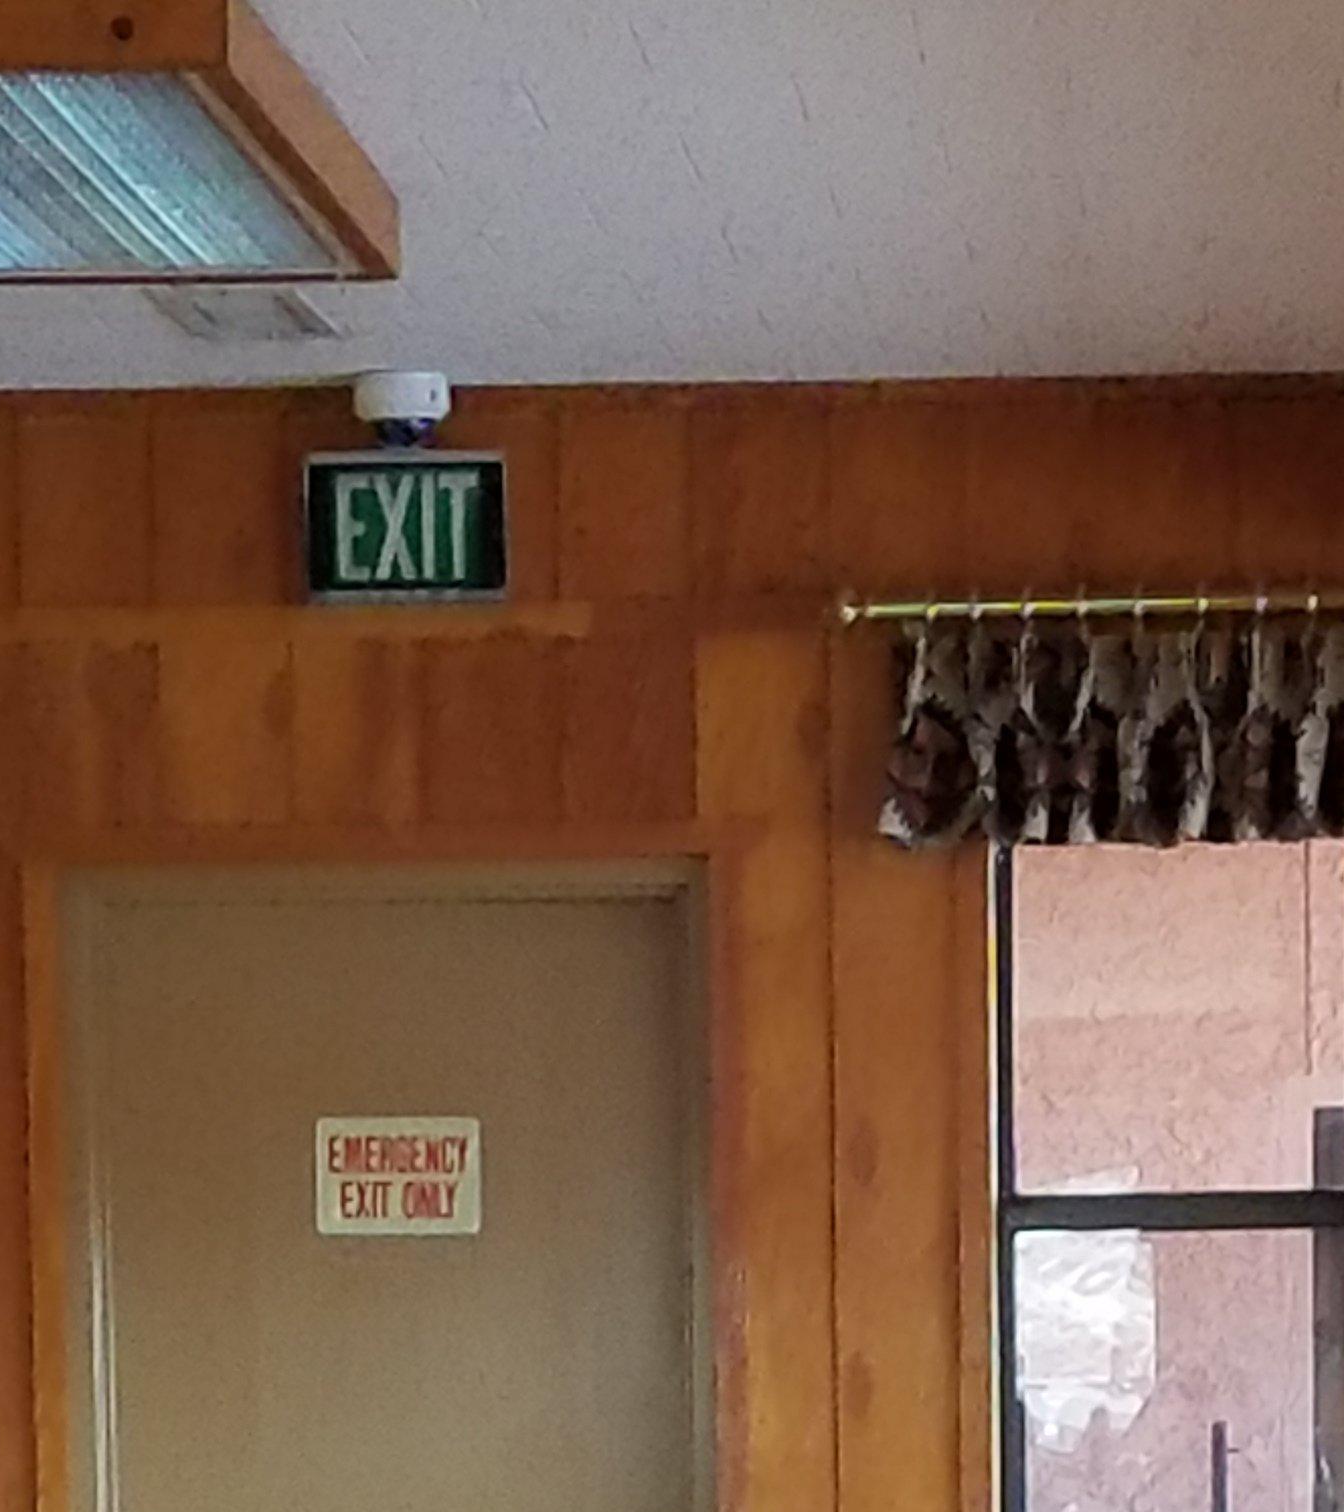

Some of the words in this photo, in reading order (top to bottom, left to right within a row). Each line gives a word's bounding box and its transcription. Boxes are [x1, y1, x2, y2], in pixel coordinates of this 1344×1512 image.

[335, 472, 479, 582] EXIT
[328, 1135, 467, 1174] EMERGENCY
[340, 1181, 392, 1219] EXIT
[402, 1181, 458, 1219] ONLY
